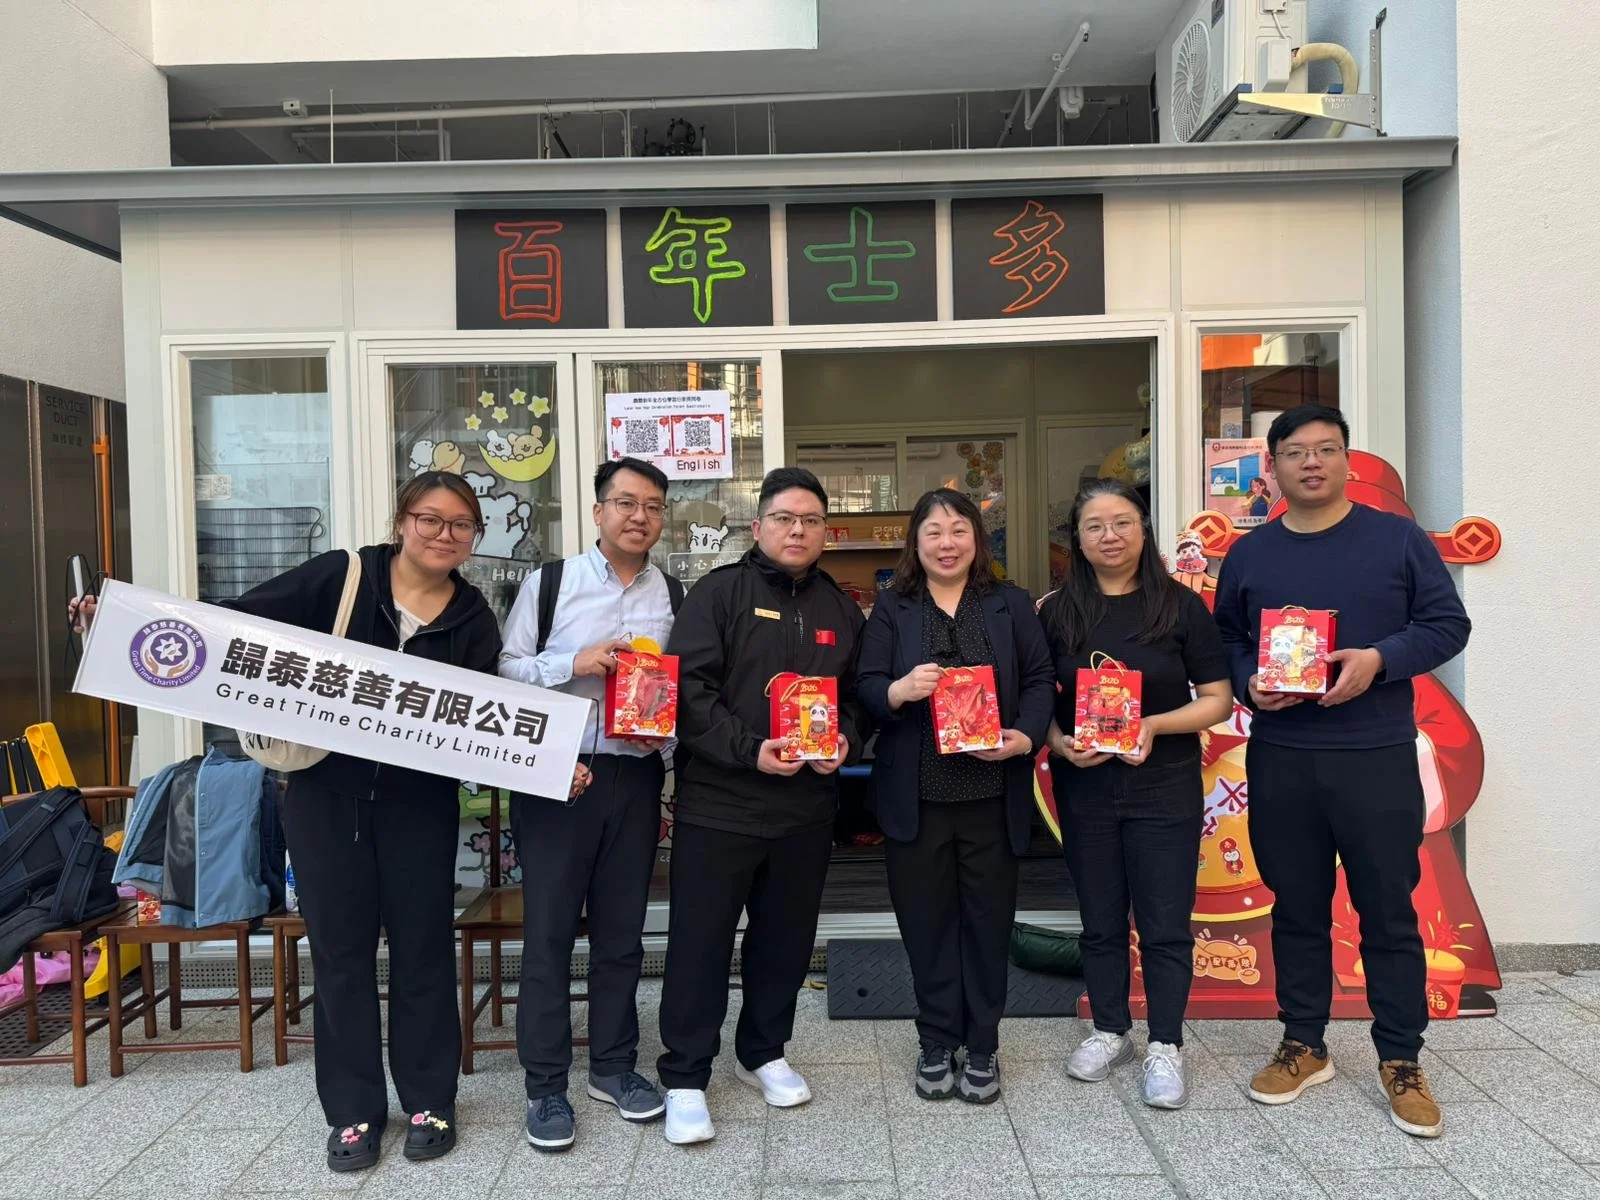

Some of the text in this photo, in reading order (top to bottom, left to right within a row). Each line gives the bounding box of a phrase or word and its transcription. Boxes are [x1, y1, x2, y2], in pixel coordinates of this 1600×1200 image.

[494, 200, 1069, 323] 百年士多
[54, 412, 79, 427] DUCT
[677, 459, 720, 471] English
[492, 568, 531, 582] Hell
[152, 677, 179, 686] Charity
[179, 664, 201, 683] Limited
[220, 637, 549, 745] 歸泰慈善有限公司
[216, 683, 537, 767] Great Time Charity Limited
[1429, 989, 1448, 1010] 福
